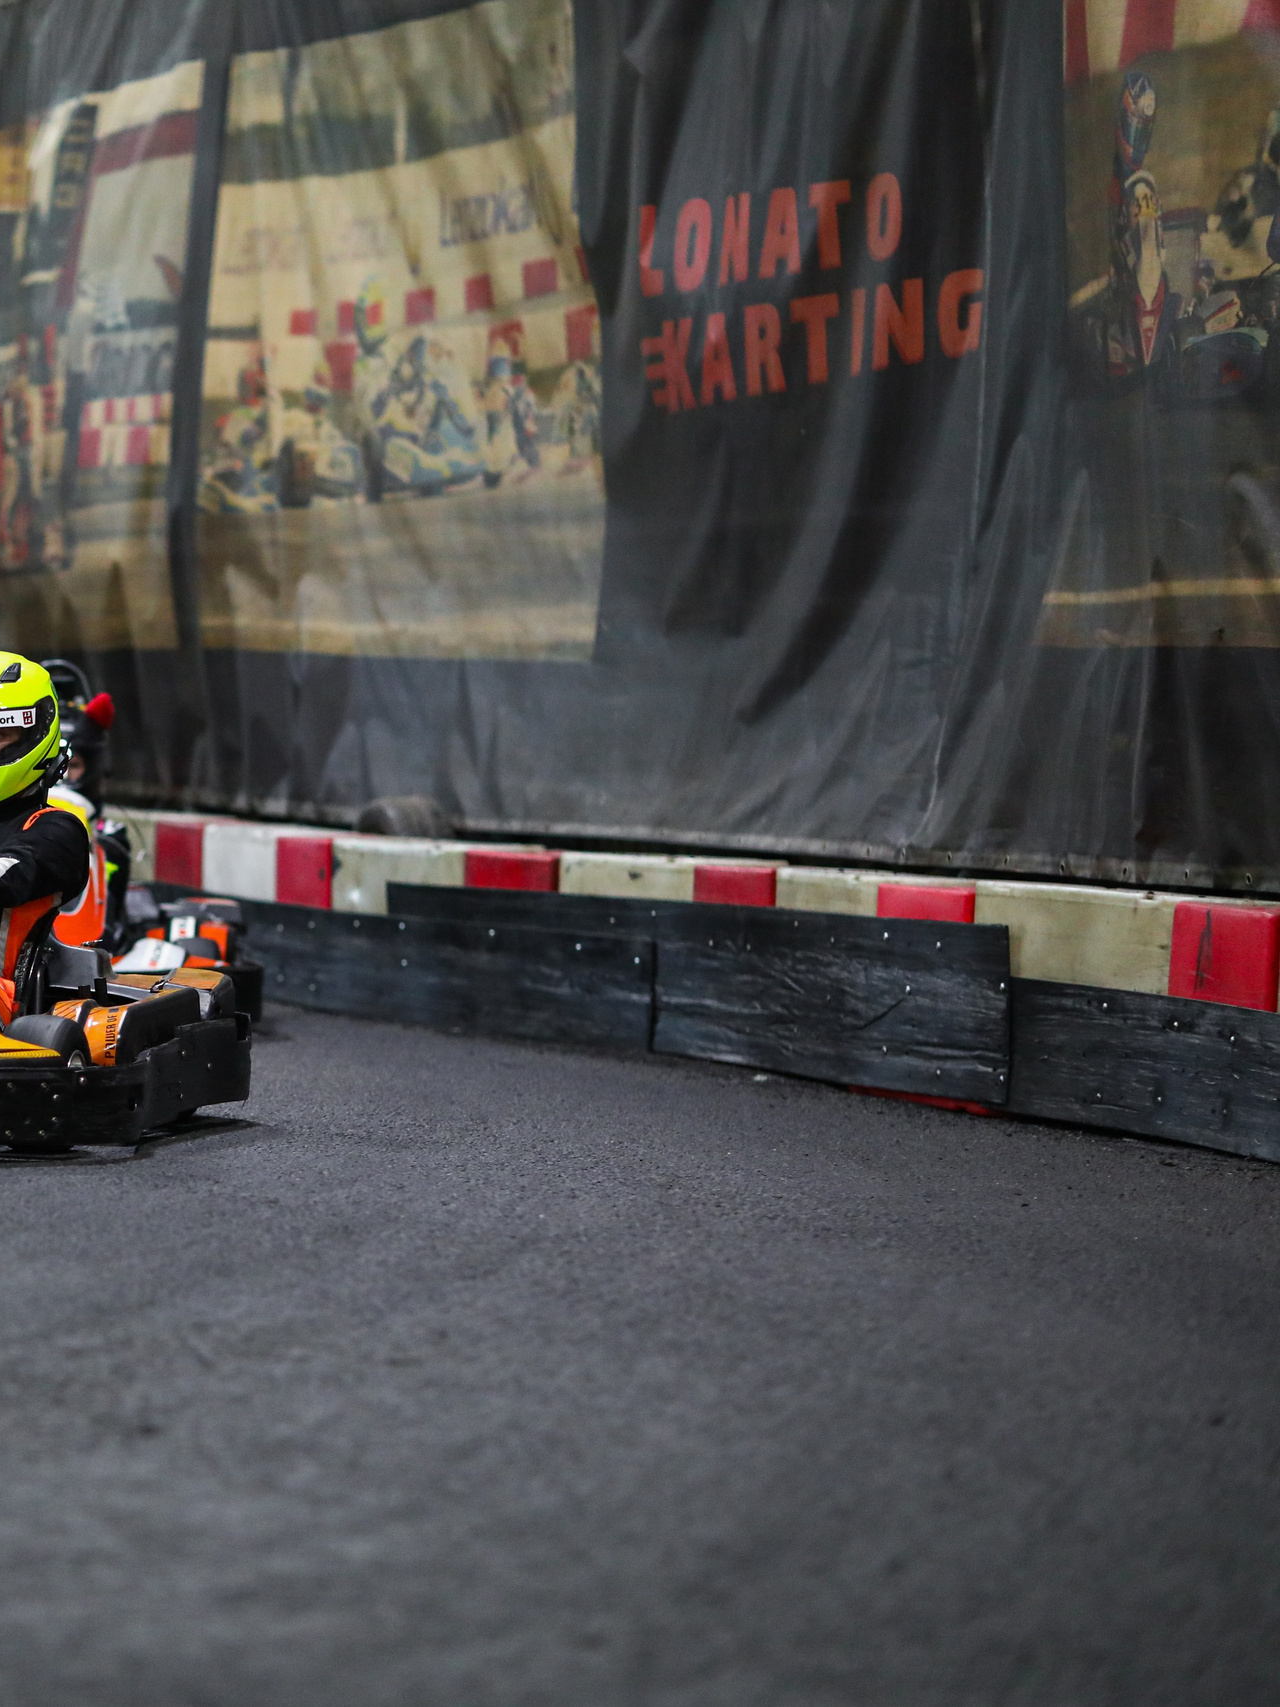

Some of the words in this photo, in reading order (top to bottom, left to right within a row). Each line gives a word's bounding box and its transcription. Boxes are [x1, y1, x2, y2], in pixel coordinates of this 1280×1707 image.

[638, 172, 903, 297] LONATO
[642, 268, 984, 413] KARTING
[105, 1023, 117, 1059] POWER
